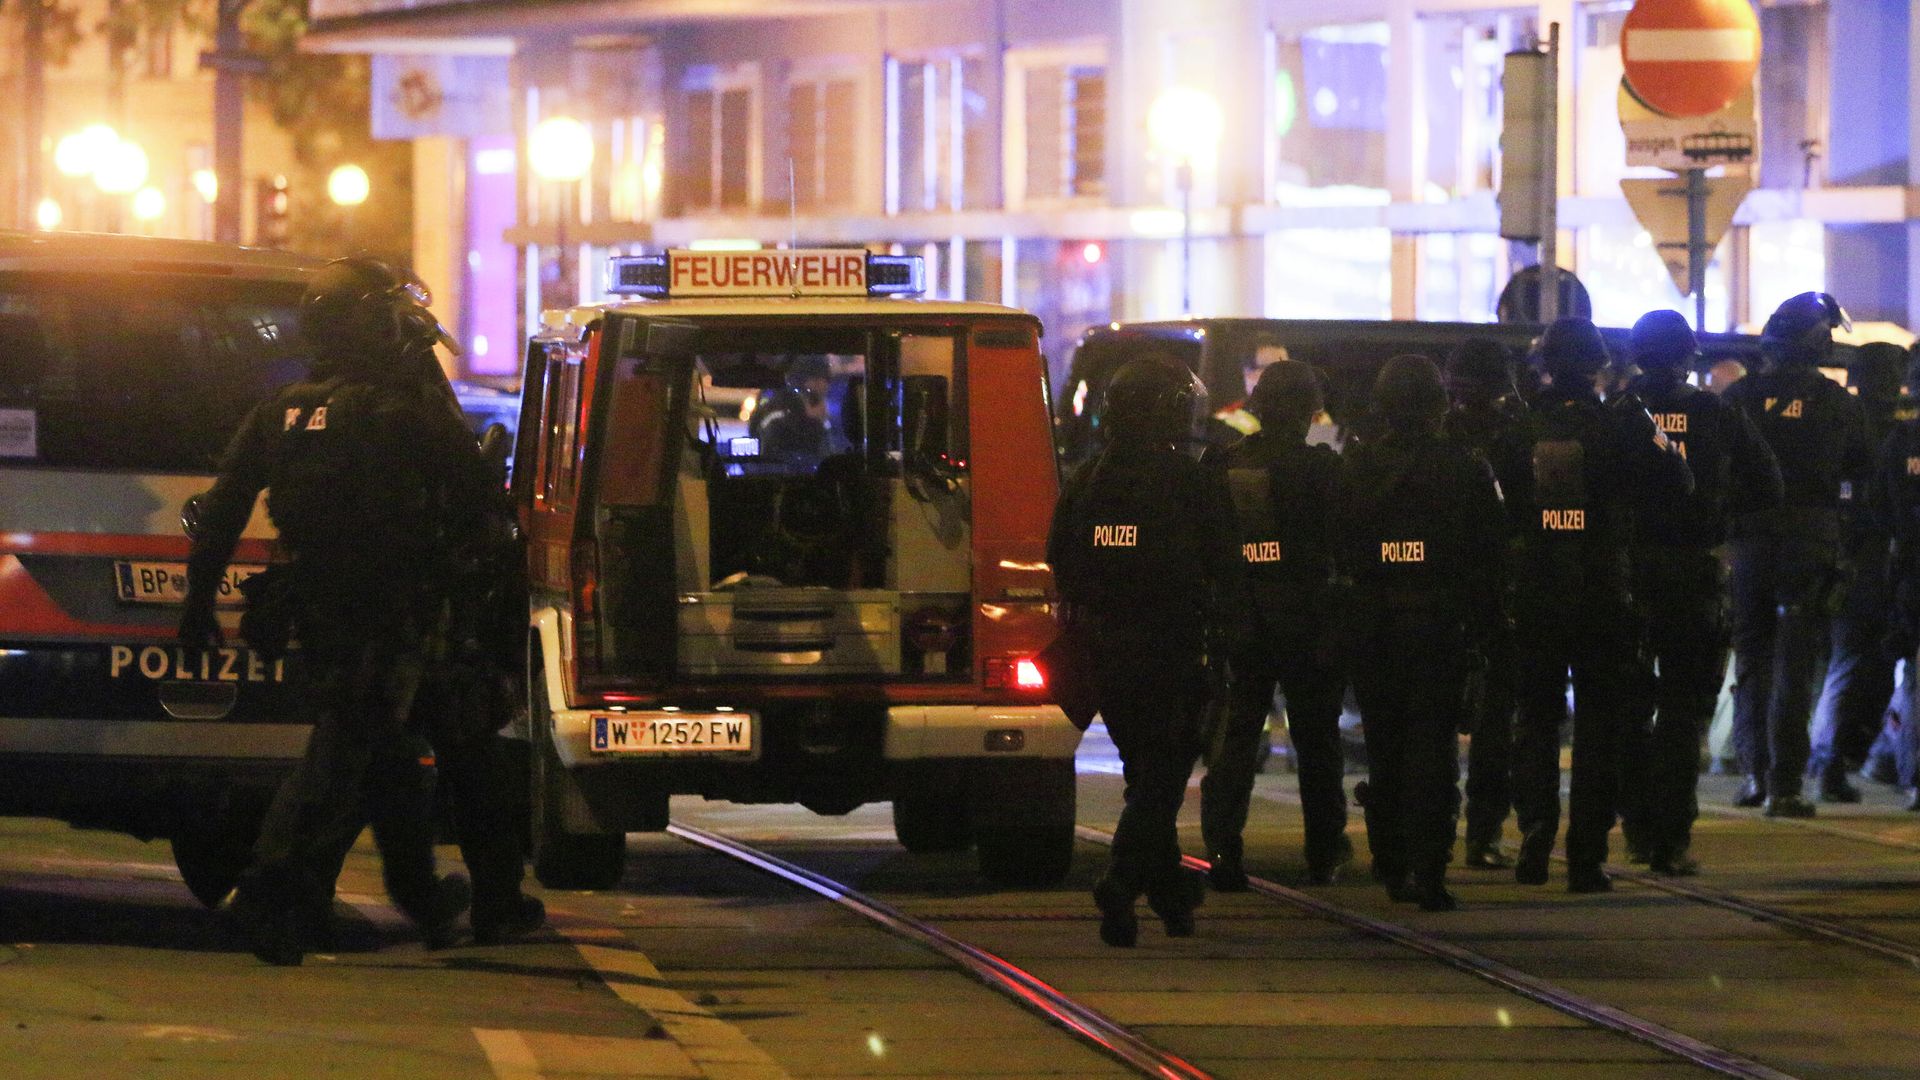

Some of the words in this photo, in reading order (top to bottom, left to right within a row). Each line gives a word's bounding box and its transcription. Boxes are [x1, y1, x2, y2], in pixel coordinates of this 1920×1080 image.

[672, 256, 864, 288] FEUERWEHR
[1652, 413, 1688, 432] OLIZEI
[1542, 509, 1585, 531] POLIZEI
[1093, 525, 1137, 547] POLIZEI
[1381, 540, 1425, 563] POLIZEI
[140, 568, 169, 594] BP
[110, 644, 285, 682] POLIZEI
[612, 722, 629, 745] W
[649, 721, 704, 745] 1252
[710, 721, 743, 745] FW
